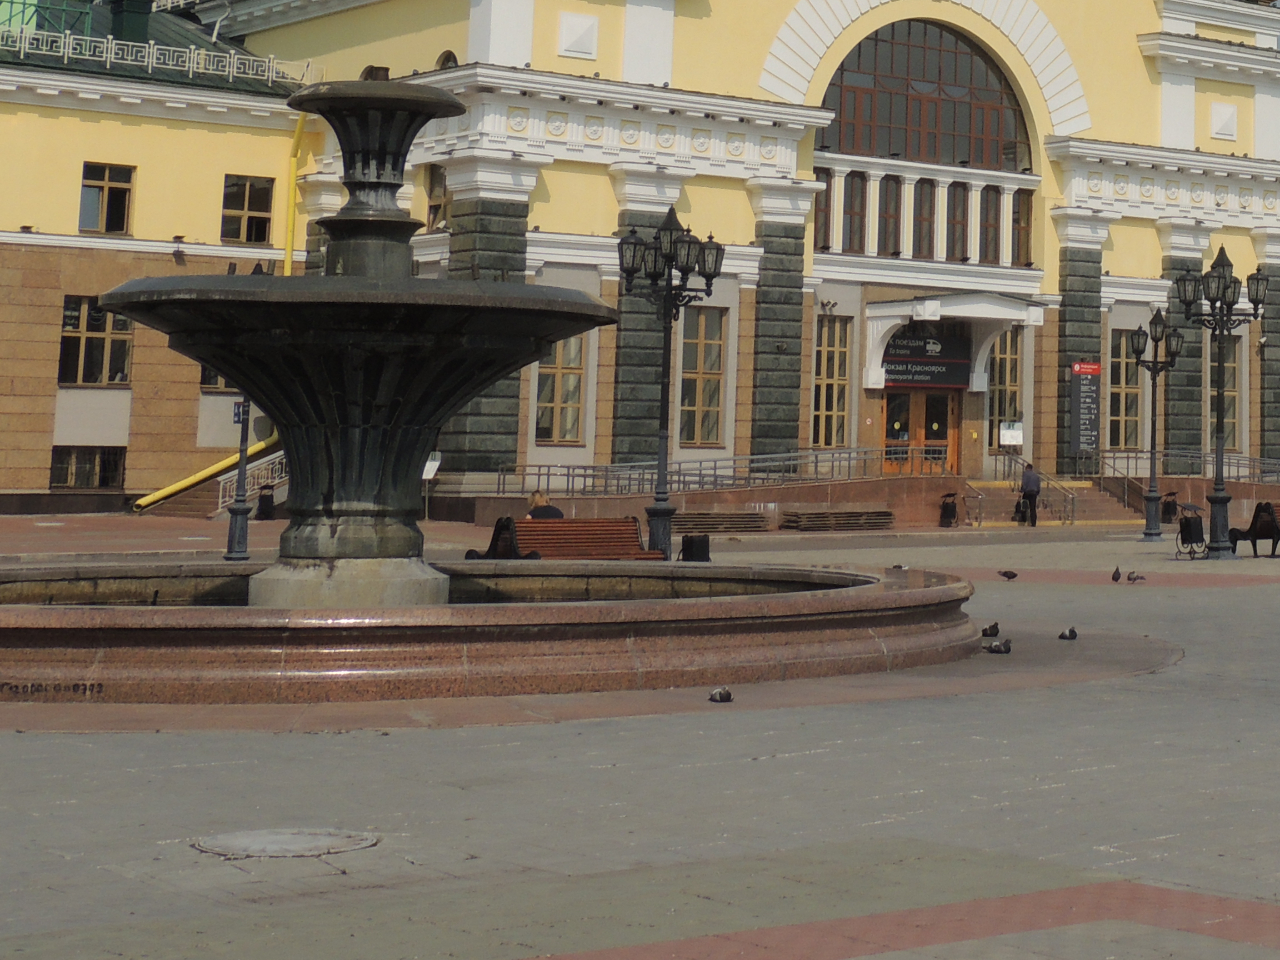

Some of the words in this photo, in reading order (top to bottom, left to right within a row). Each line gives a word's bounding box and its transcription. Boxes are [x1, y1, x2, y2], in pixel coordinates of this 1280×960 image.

[895, 339, 924, 347] поездам
[883, 362, 906, 371] Вокзал
[907, 363, 947, 374] Красноярск
